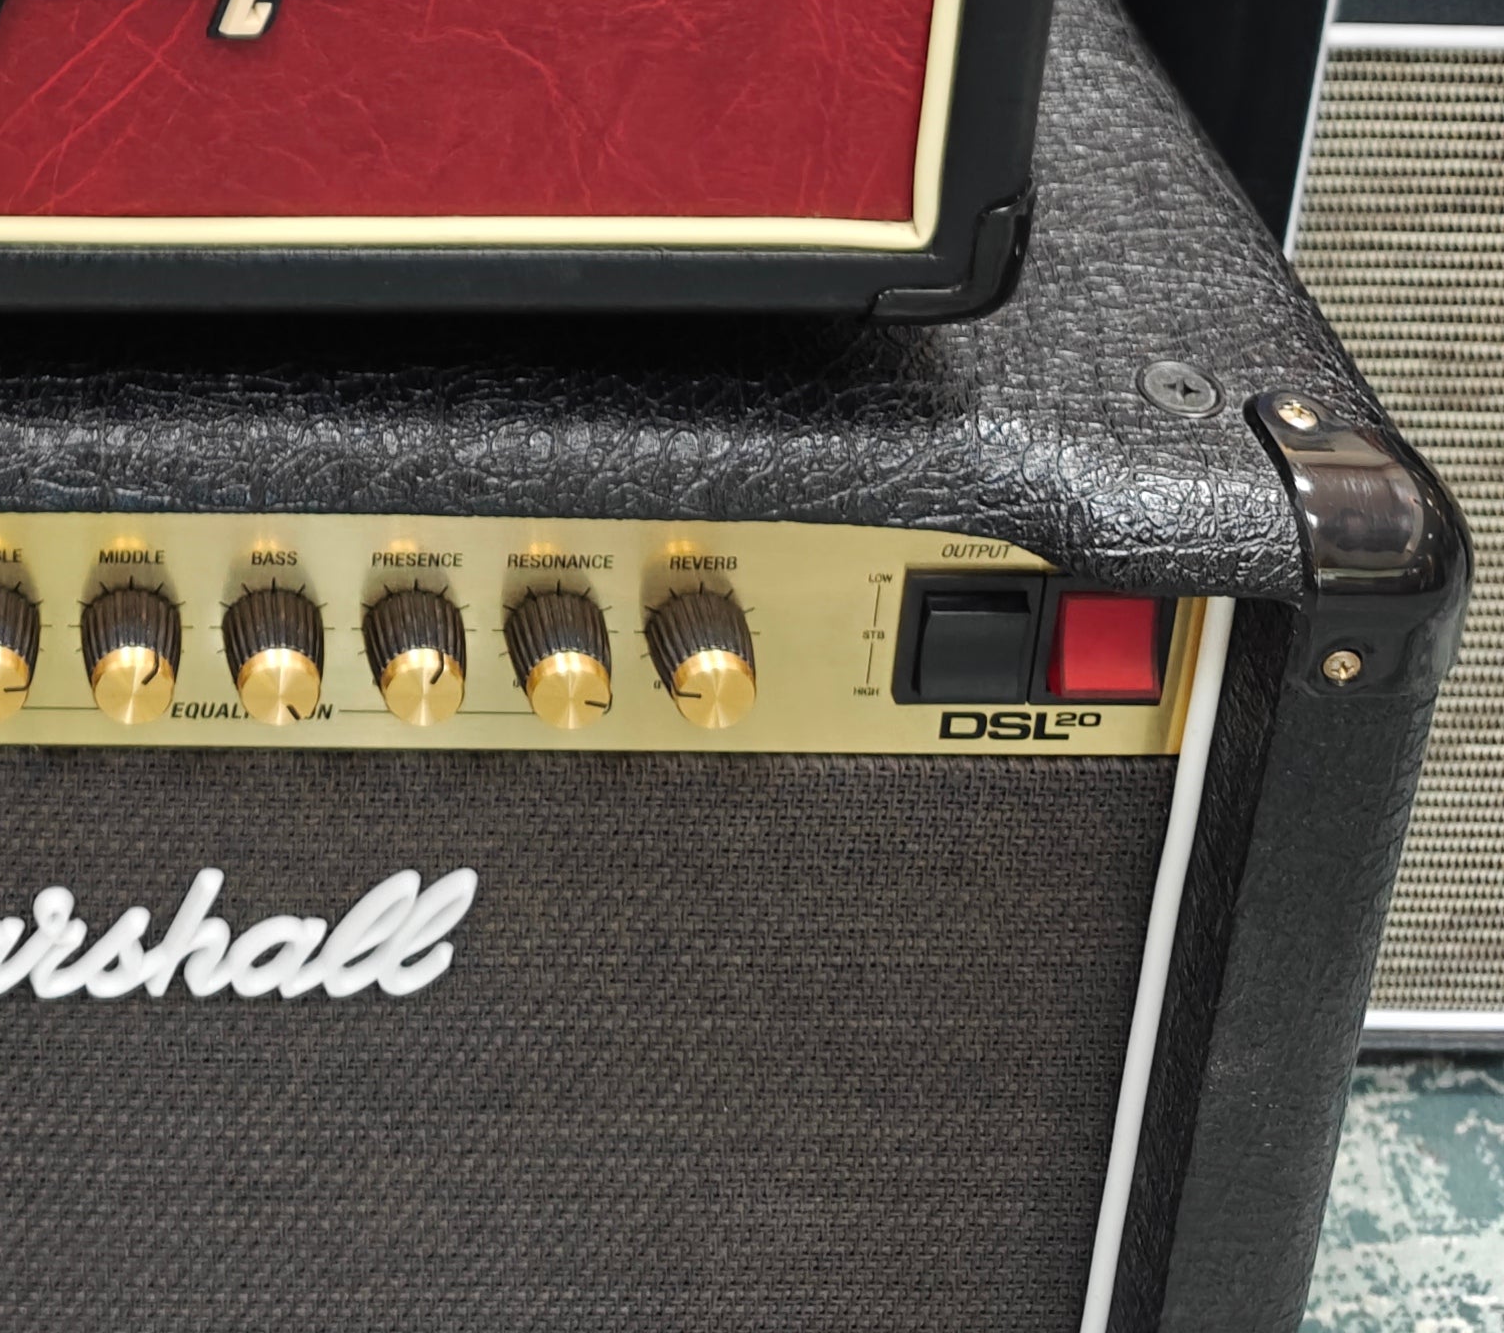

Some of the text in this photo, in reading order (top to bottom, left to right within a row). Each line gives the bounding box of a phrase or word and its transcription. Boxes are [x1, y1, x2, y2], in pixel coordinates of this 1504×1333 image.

[98, 549, 166, 565] MIDDLE
[250, 550, 298, 566] BASS
[941, 543, 1015, 559] OUTPUT
[371, 551, 463, 568] PRESENCE
[507, 553, 614, 570] RESONANCE
[669, 555, 738, 572] REVERB
